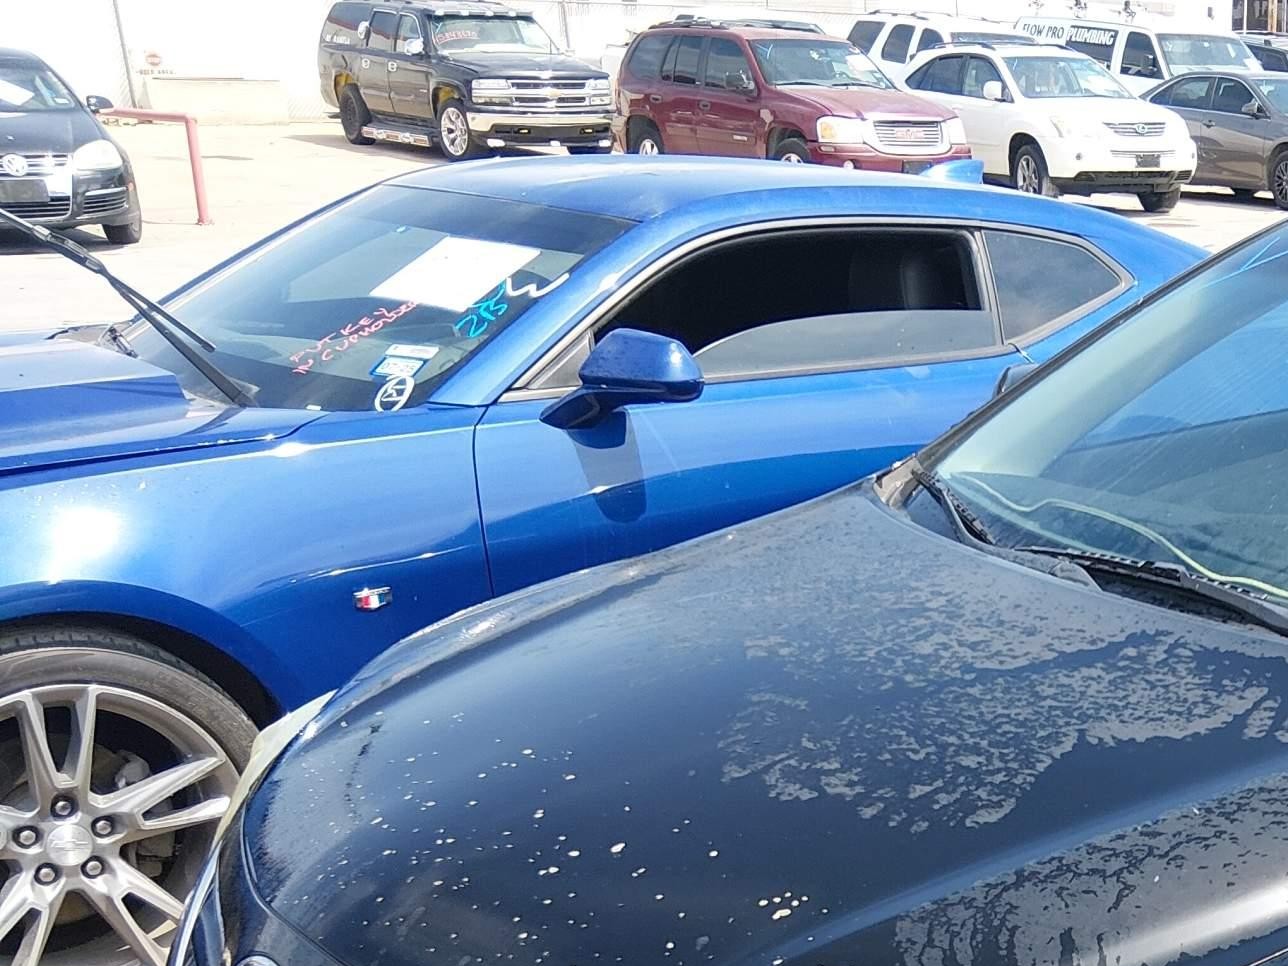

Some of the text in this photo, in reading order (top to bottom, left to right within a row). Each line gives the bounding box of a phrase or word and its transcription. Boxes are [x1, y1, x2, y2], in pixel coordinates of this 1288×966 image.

[1046, 25, 1065, 40] PRO
[1066, 27, 1115, 46] PLUMBING
[339, 306, 396, 336] KEY
